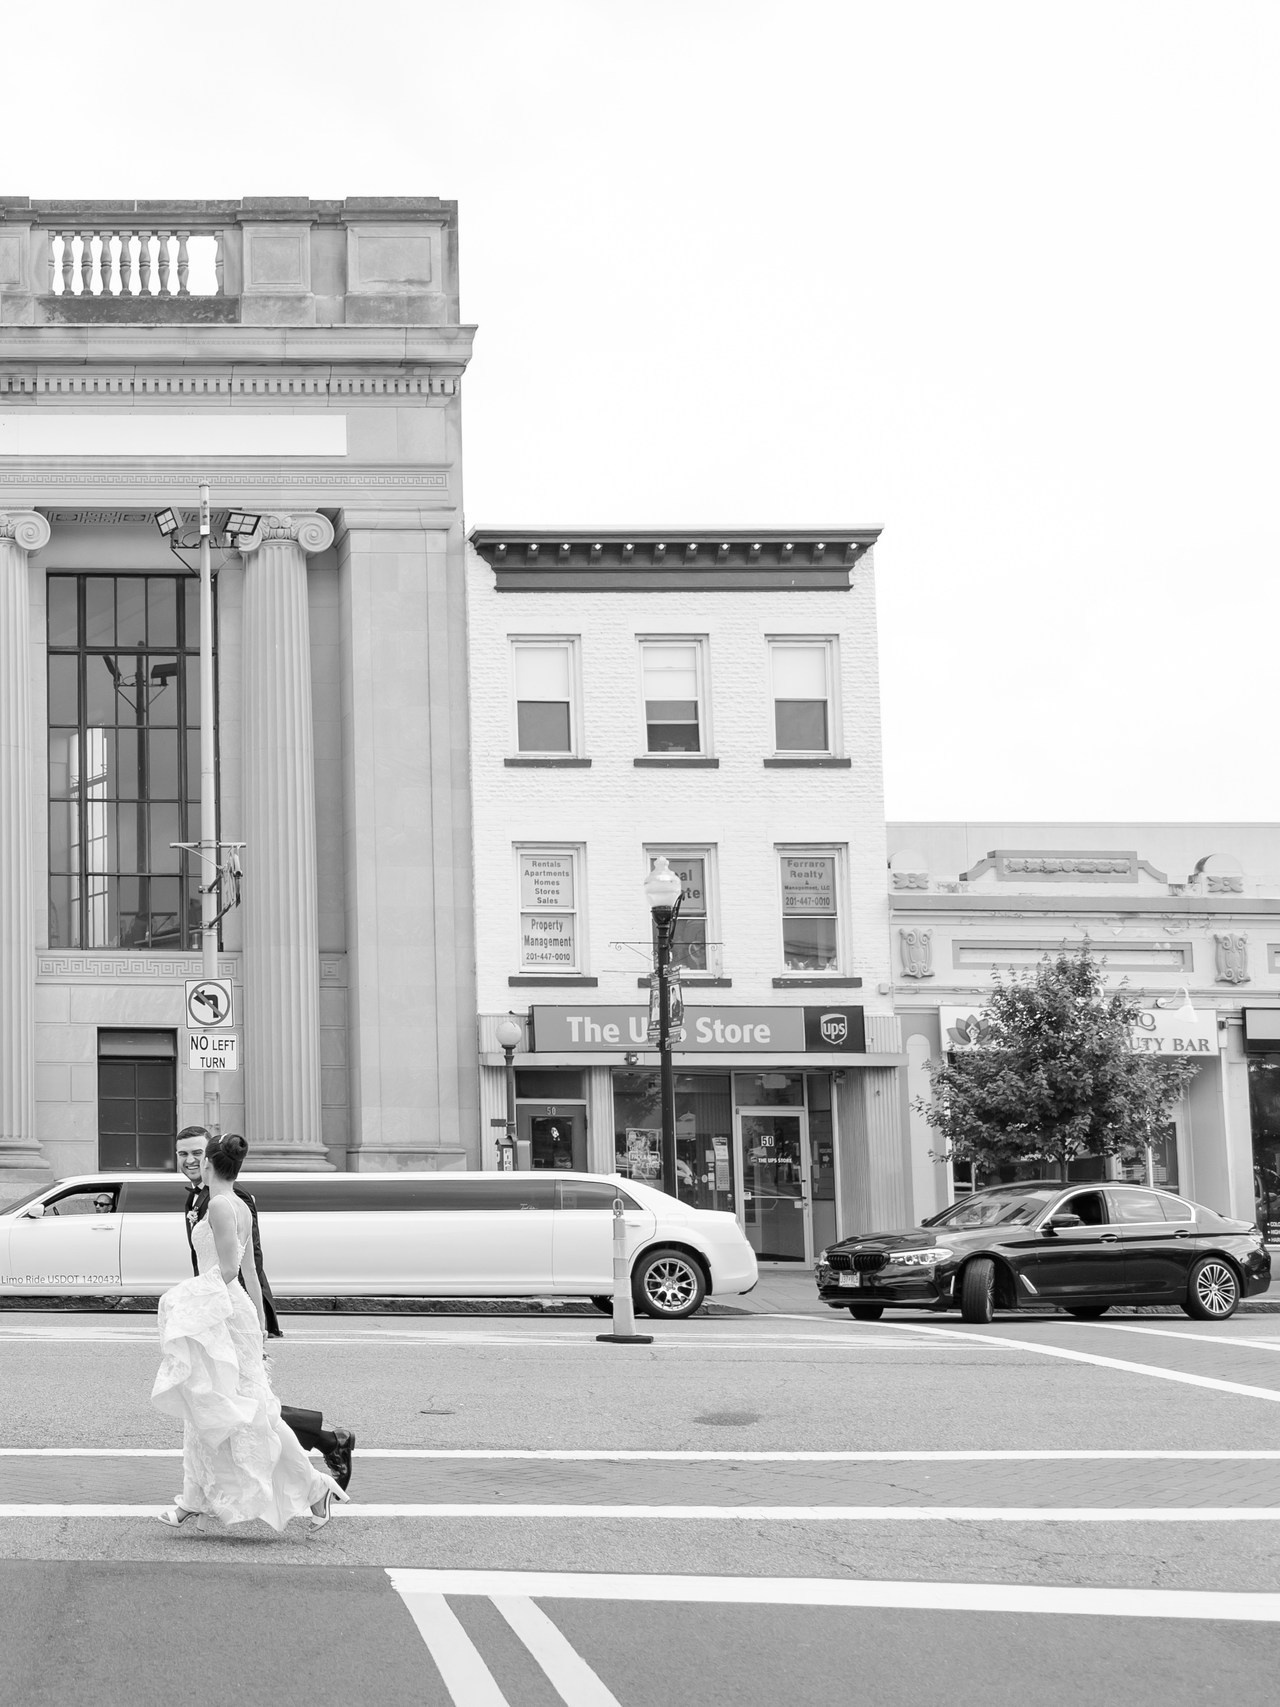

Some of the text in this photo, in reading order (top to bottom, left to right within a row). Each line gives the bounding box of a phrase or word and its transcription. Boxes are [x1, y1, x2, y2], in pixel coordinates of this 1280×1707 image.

[787, 860, 825, 868] Ferraro
[790, 870, 823, 879] Realty
[786, 897, 830, 905] 201-447-0010
[531, 919, 563, 932] Property
[524, 935, 571, 948] Management
[566, 1016, 620, 1042] The
[696, 1016, 771, 1043] Store
[823, 1023, 845, 1040] ups
[191, 1036, 235, 1051] NO LEFT
[1173, 1038, 1210, 1052] BAR
[200, 1057, 225, 1068] TURN
[547, 1107, 556, 1115] 50
[762, 1136, 773, 1145] 50
[1, 1275, 120, 1284] Limo Ride USDOT 1420432
